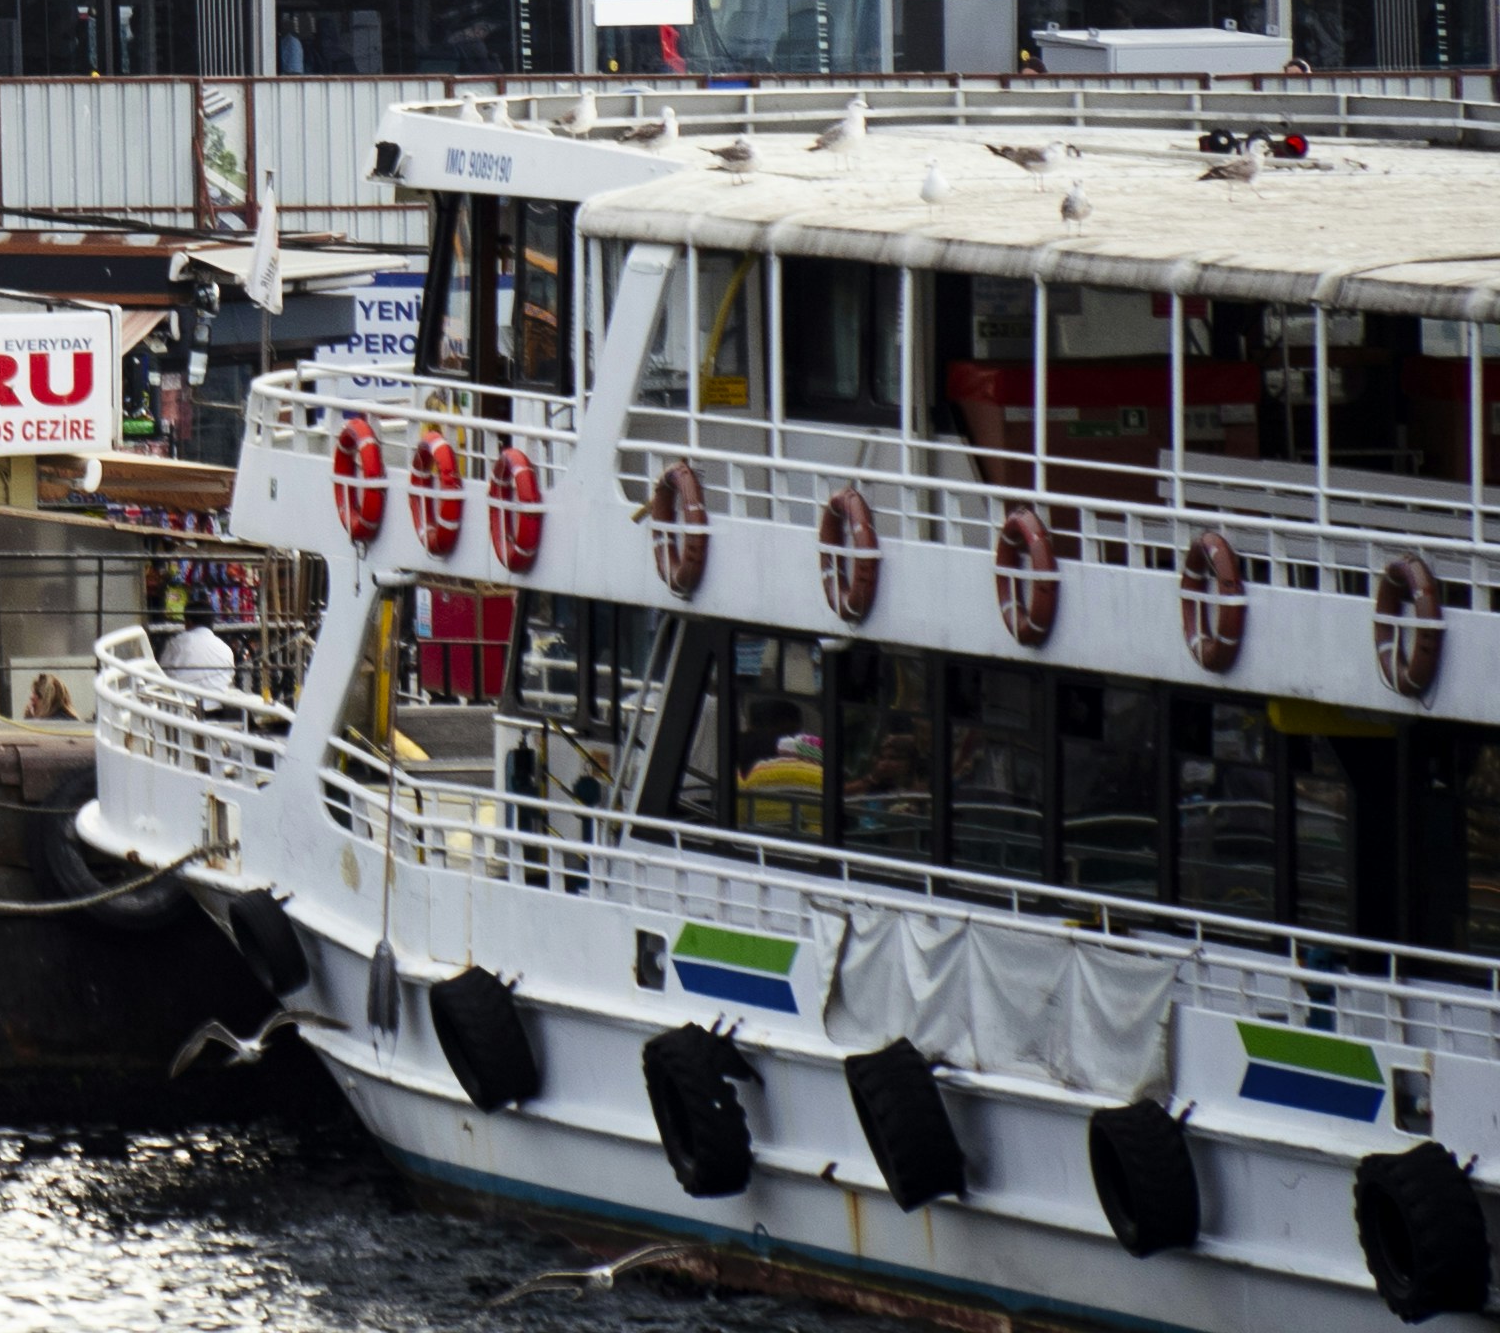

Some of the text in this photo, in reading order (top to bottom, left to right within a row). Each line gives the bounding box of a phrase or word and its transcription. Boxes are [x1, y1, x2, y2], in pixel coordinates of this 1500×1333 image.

[445, 148, 466, 176] IMO
[358, 295, 421, 322] YENİ
[4, 337, 93, 352] EVERYDAY
[22, 415, 96, 441] CEZİRE
